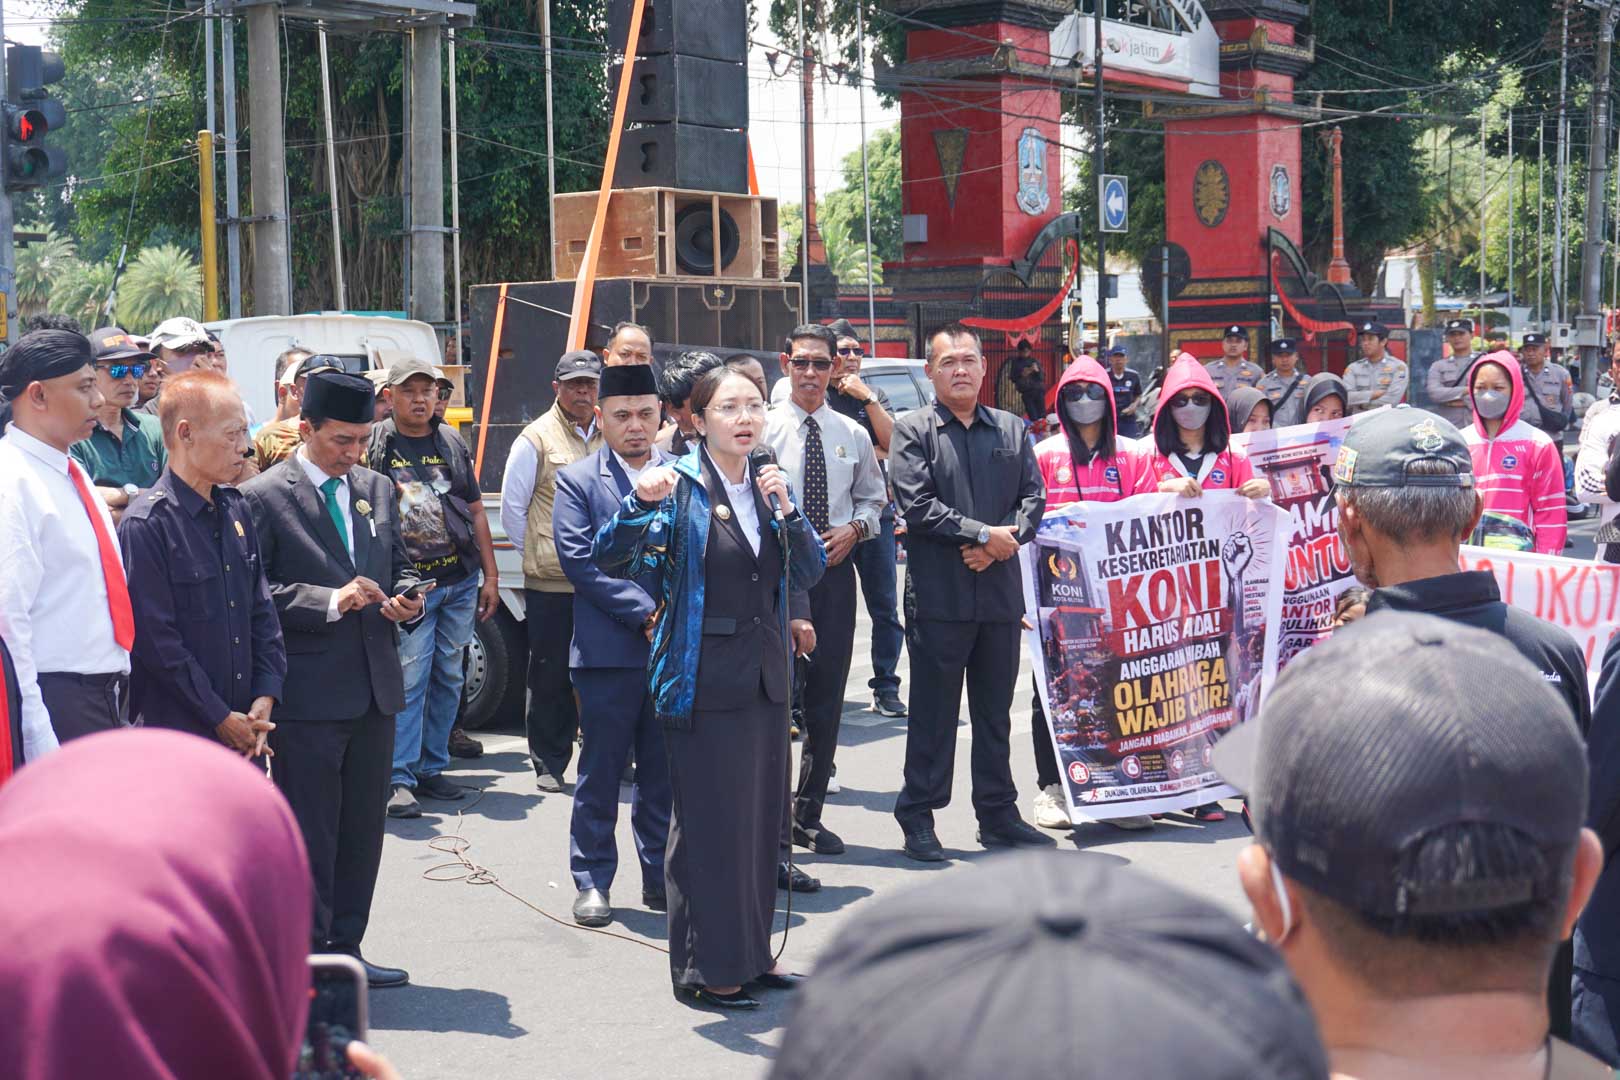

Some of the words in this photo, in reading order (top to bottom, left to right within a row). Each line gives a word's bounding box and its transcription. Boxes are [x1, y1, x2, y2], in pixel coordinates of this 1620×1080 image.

[1129, 40, 1159, 58] jatim
[1104, 507, 1205, 556] KANTOR
[1097, 538, 1220, 579] KESEKRETARIATAN
[1284, 536, 1351, 591] UNTU
[1051, 583, 1084, 598] KONI
[1107, 559, 1221, 631] KONI
[1281, 599, 1331, 619] ANTOR
[1283, 587, 1330, 605] NGGUNAAN
[1123, 620, 1179, 654] HARUS
[1182, 611, 1221, 639] ADA!
[1113, 657, 1226, 711] OLAHRAGA
[1120, 647, 1186, 681] ANGGARAN
[1117, 697, 1187, 737] WAJIB
[1118, 736, 1152, 753] JANGAN
